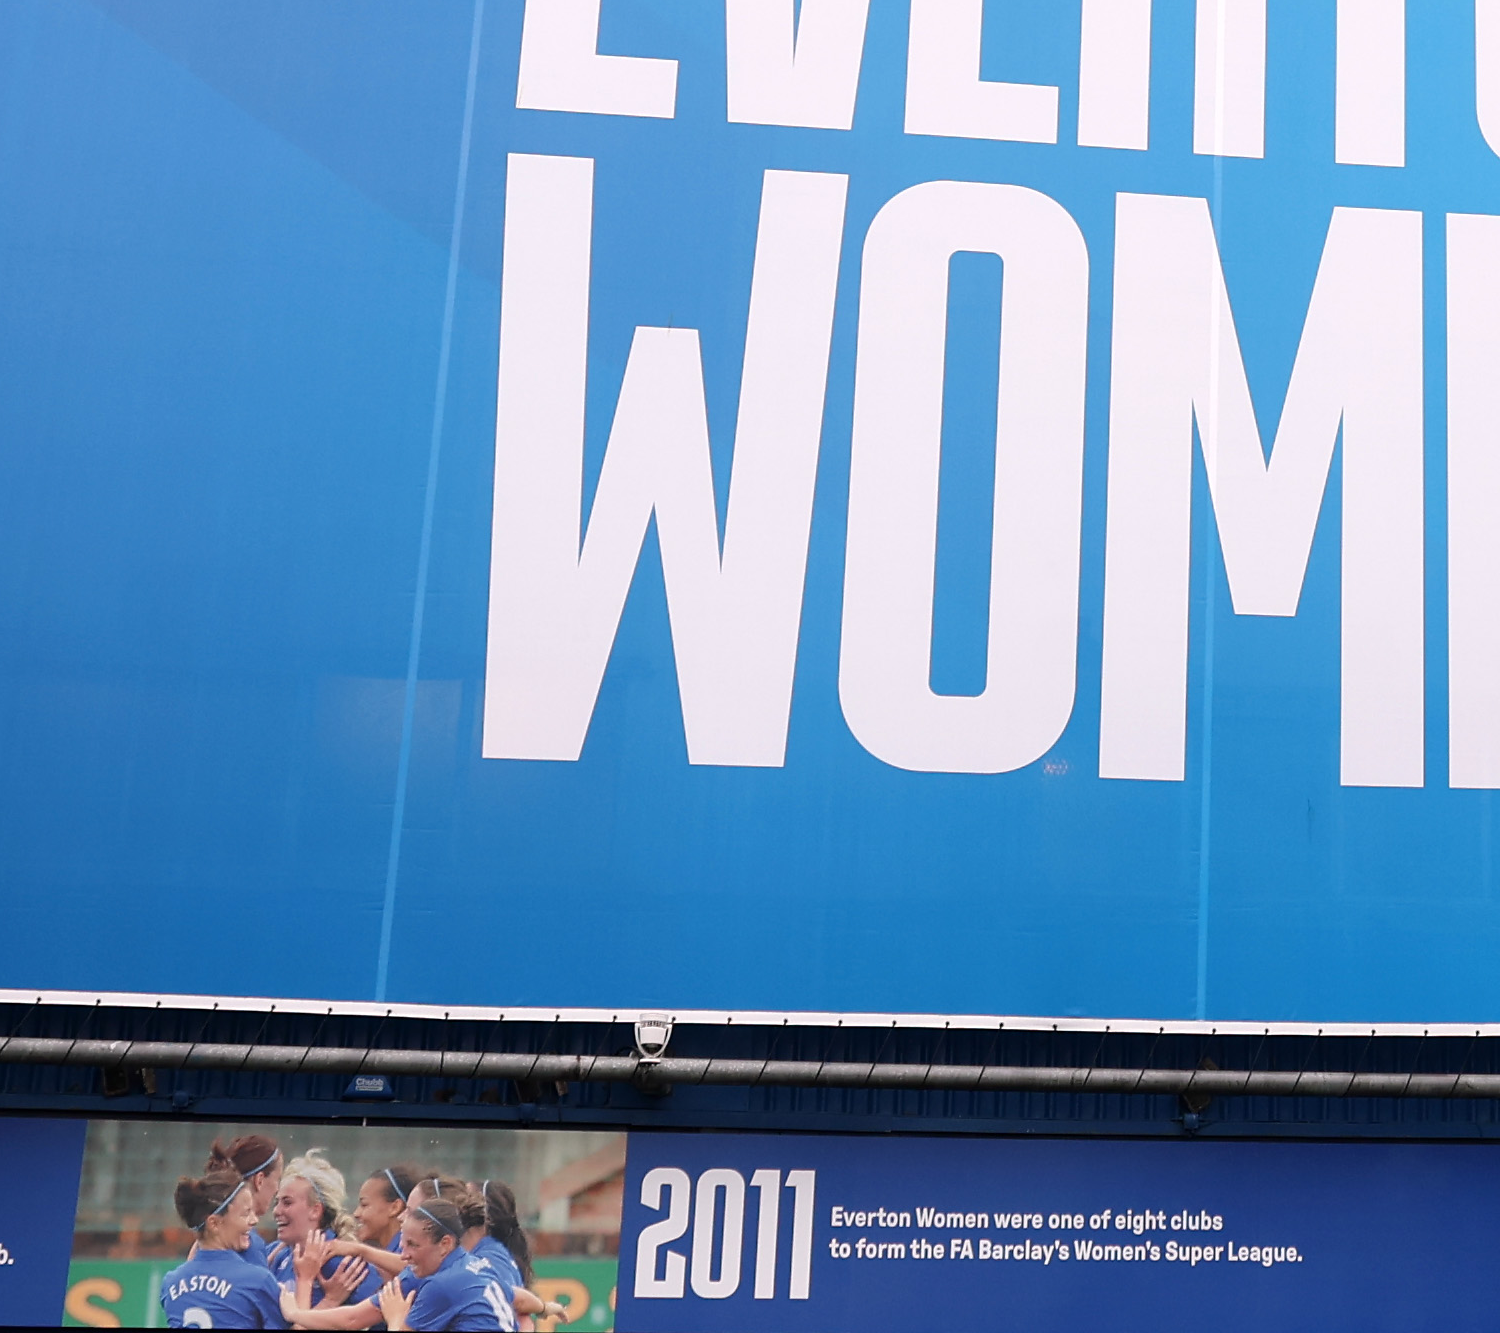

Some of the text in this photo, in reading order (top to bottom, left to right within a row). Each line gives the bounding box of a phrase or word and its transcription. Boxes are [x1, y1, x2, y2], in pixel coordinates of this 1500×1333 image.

[634, 1167, 815, 1300] 2011
[830, 1207, 1223, 1235] Everton Women were one of eight clubs
[829, 1238, 1304, 1267] to form the FA Barclay's Women's Super League.
[168, 1275, 232, 1301] EASTON
